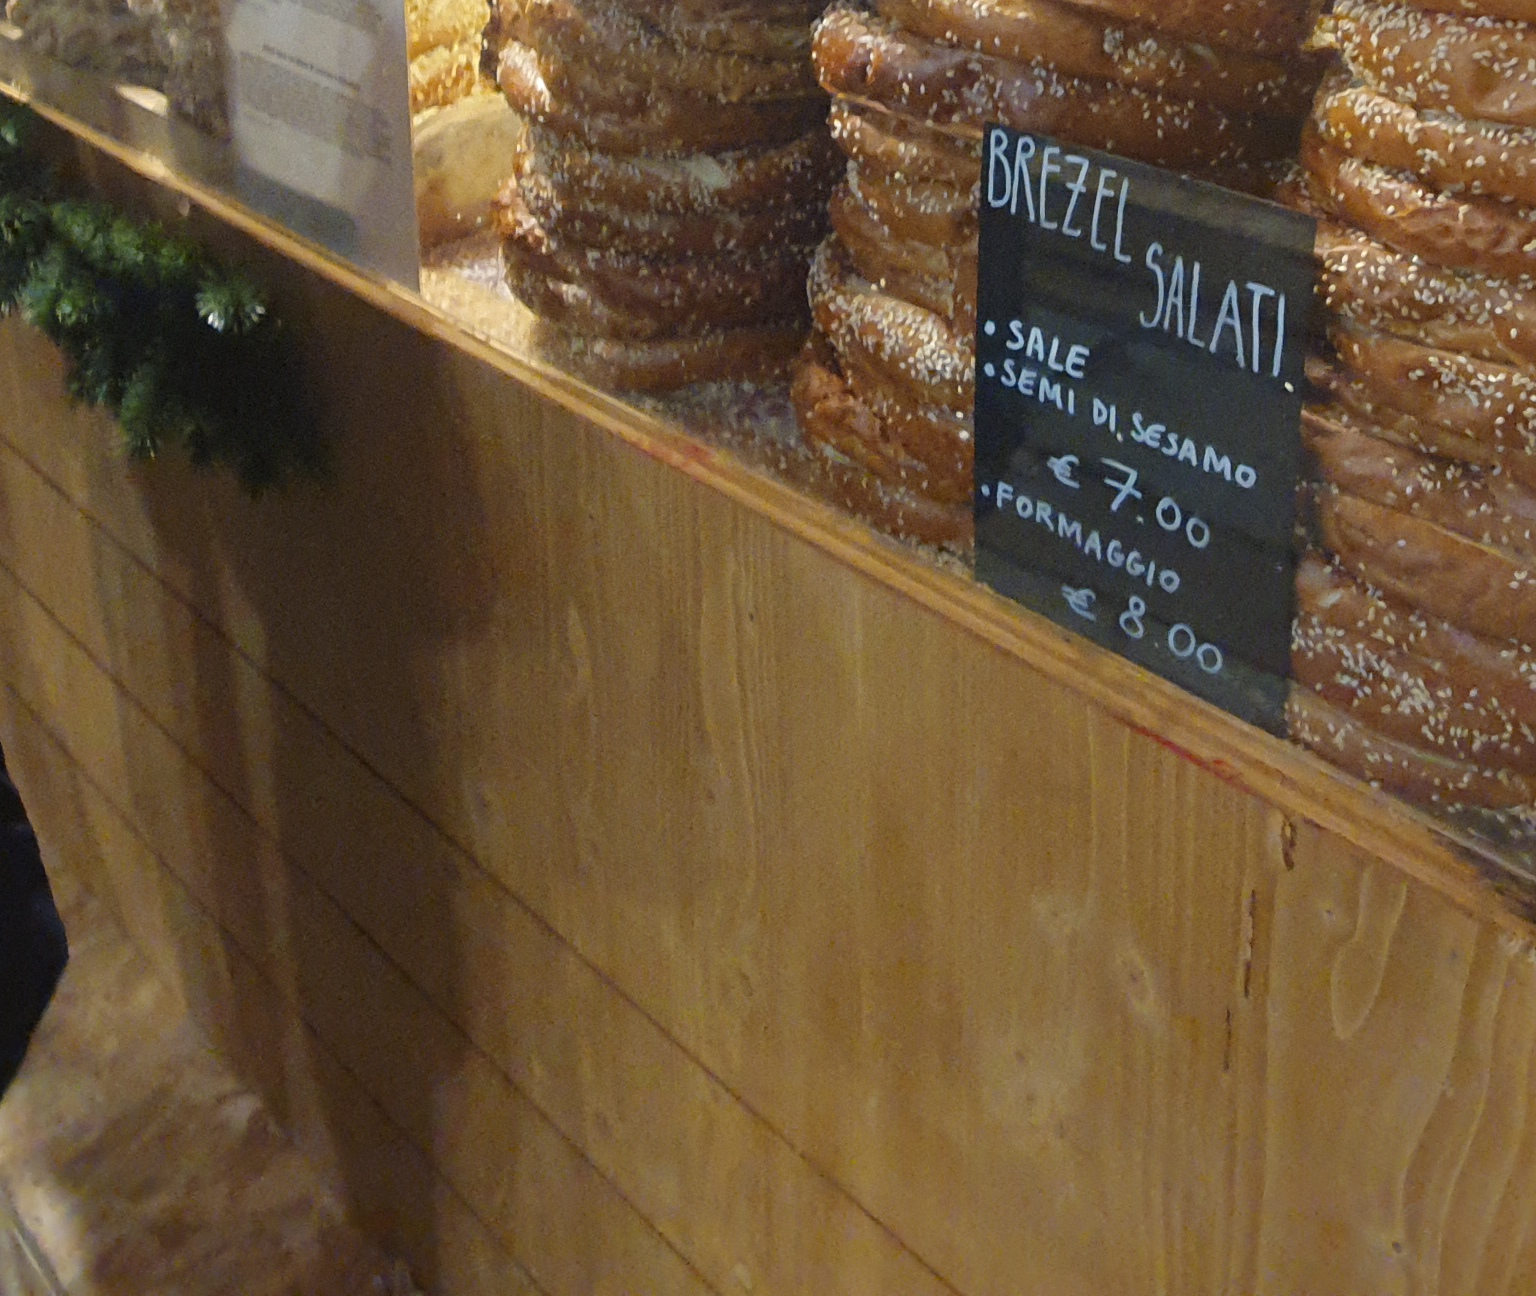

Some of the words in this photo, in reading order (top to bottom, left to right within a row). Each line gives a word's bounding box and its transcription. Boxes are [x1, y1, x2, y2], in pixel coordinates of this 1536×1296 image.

[987, 127, 1132, 264] BREZEL
[1138, 241, 1286, 378] SALATI
[1005, 319, 1090, 380] SALE
[1000, 358, 1075, 415] SEMI
[1130, 411, 1258, 489] SESAMO
[995, 481, 1181, 594] FORMAGGIO
